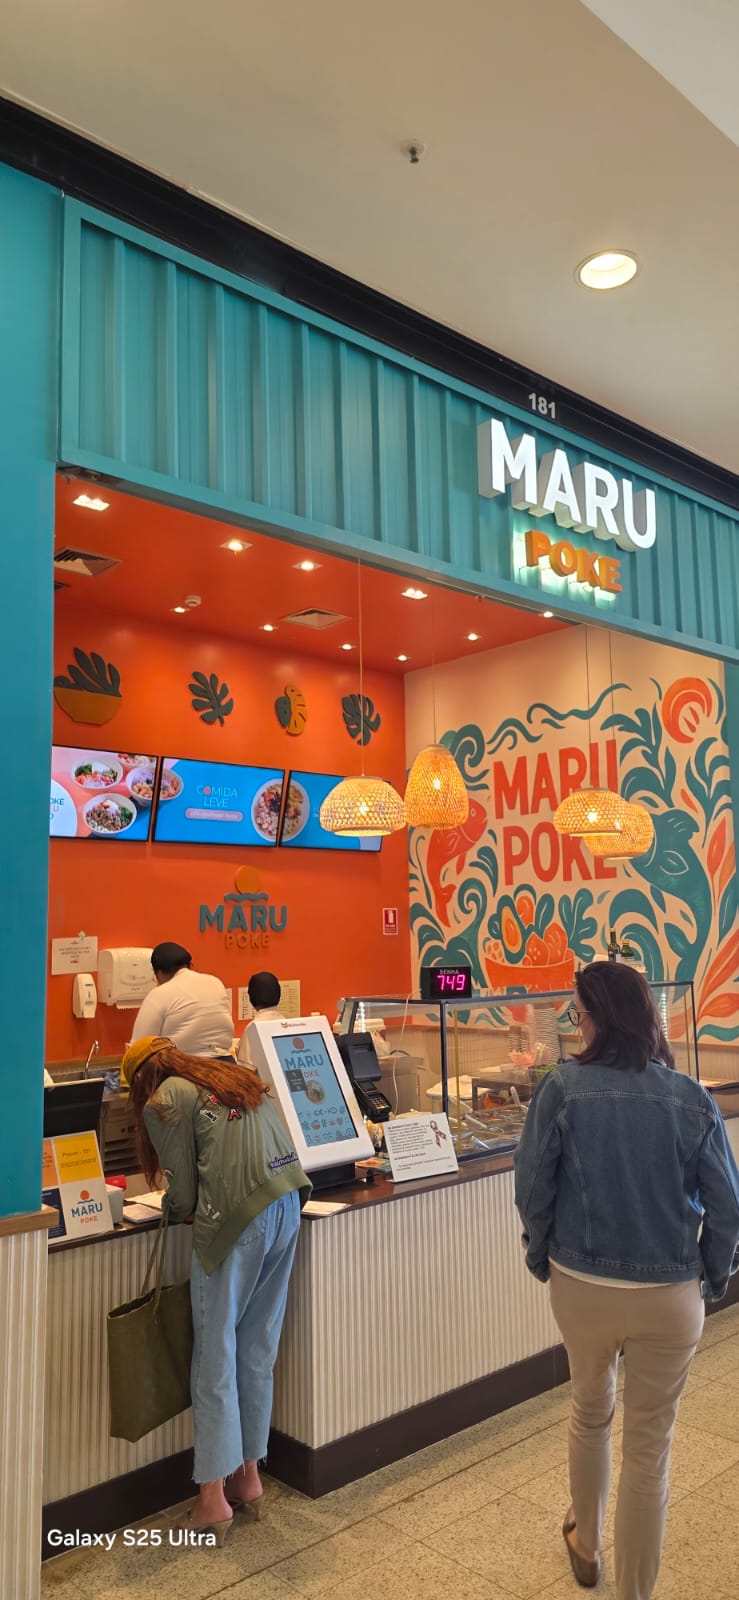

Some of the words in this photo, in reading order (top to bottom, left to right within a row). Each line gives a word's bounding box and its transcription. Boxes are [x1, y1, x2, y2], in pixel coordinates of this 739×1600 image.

[529, 393, 556, 419] 181
[479, 418, 656, 551] MARU
[525, 530, 622, 593] POKE
[493, 739, 618, 819] MARU
[196, 784, 238, 798] COMIDA
[203, 797, 229, 808] LEVE
[199, 904, 288, 933] MARU
[225, 934, 269, 950] POKE
[436, 974, 465, 991] 749
[284, 1054, 324, 1069] MARU
[303, 1070, 320, 1078] OKE
[71, 1202, 103, 1218] MARU
[80, 1216, 98, 1224] POKE
